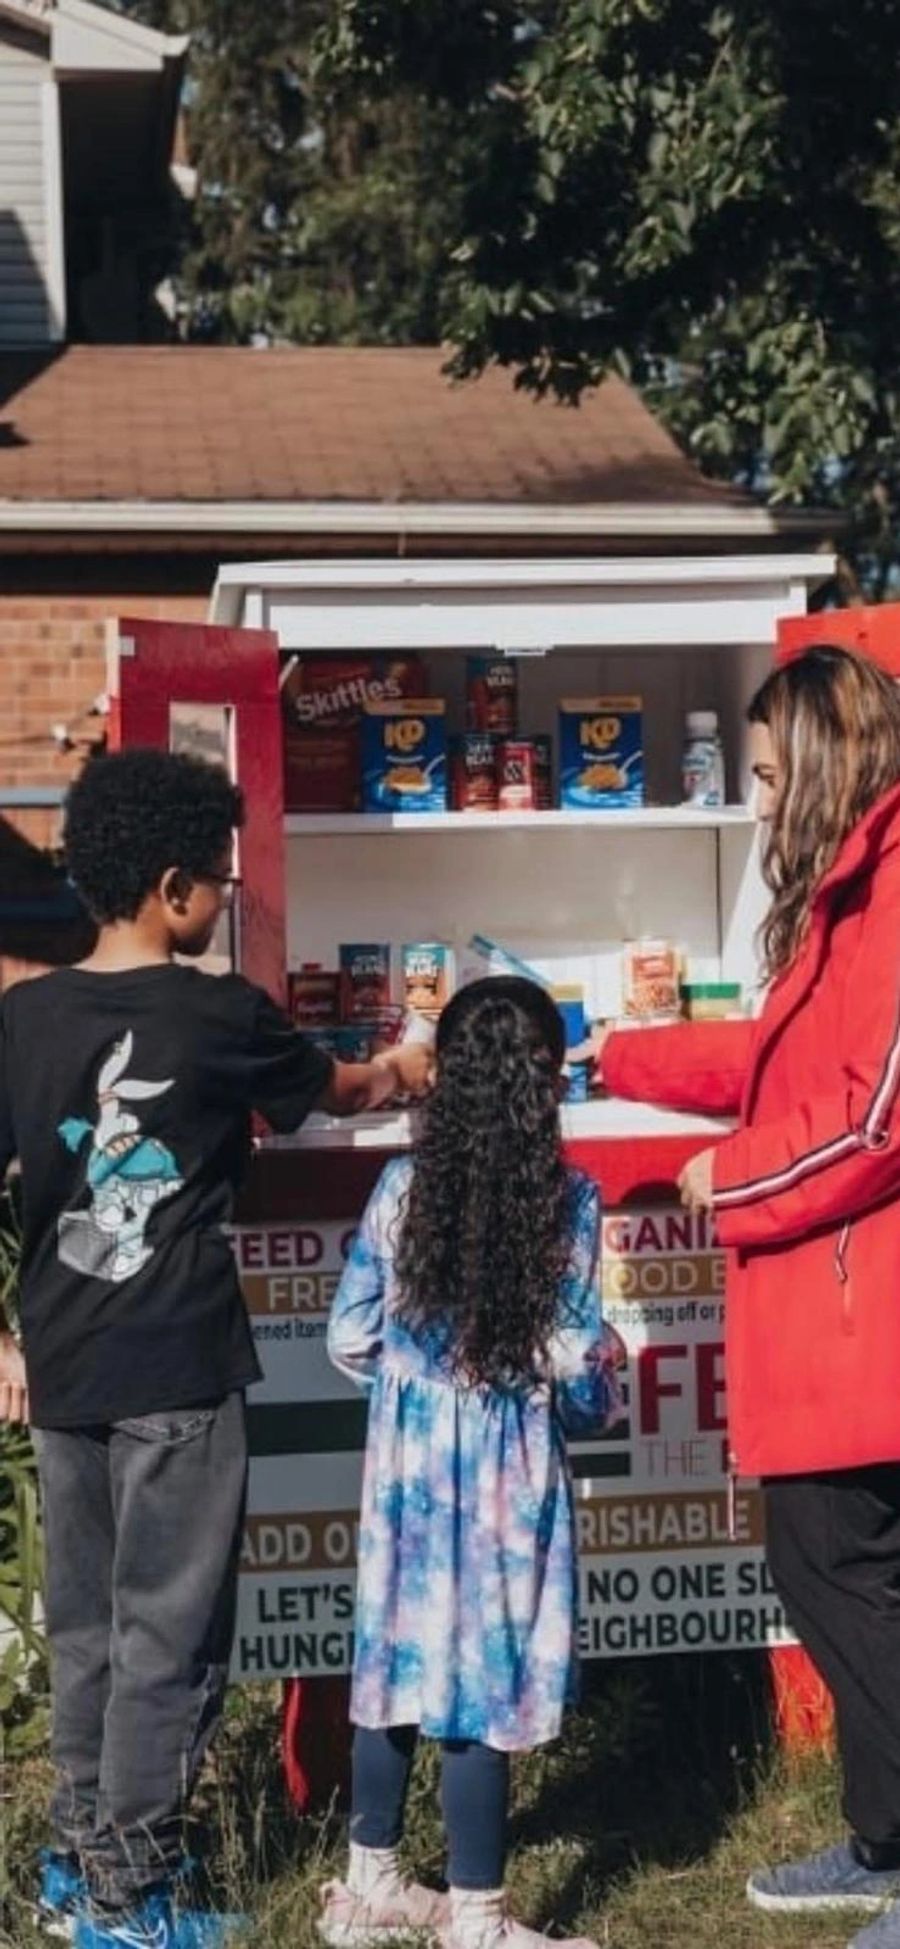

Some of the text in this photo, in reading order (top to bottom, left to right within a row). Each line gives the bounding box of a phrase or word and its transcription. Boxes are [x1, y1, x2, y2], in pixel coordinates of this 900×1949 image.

[295, 678, 402, 721] Skittles
[639, 1437, 706, 1478] THE
[258, 1583, 355, 1624] LET'S
[587, 1568, 640, 1604] NO
[651, 1563, 726, 1602] ONE
